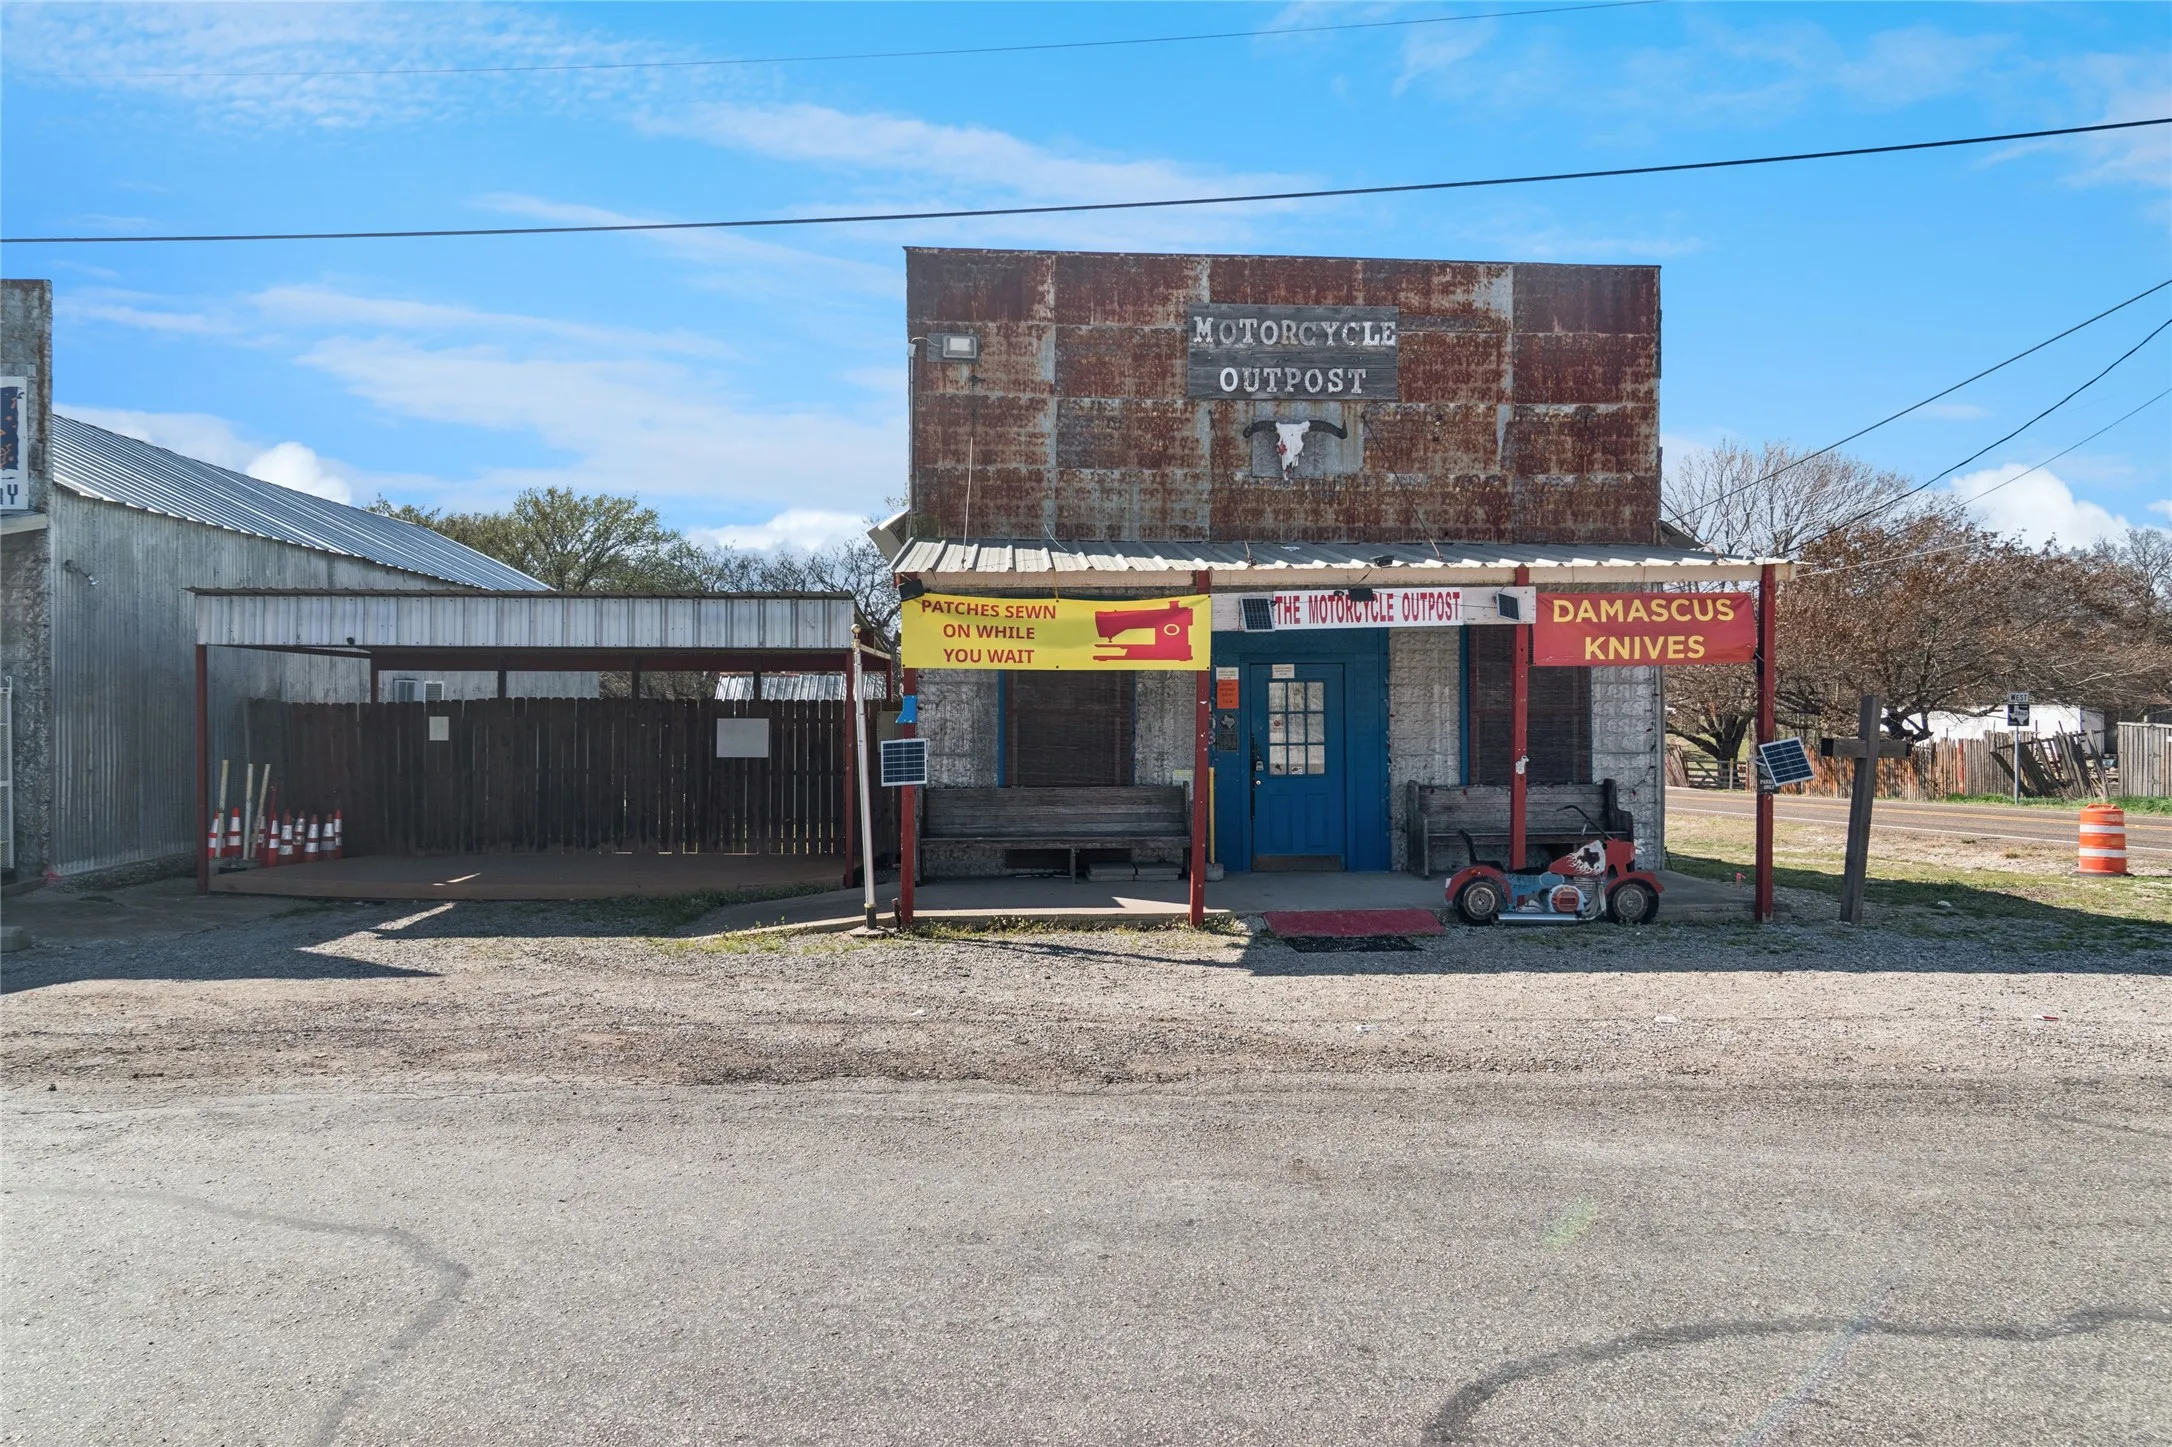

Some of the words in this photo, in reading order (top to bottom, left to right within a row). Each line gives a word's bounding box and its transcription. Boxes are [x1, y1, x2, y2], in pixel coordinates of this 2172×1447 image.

[1193, 316, 1396, 346] MOTORCYCLE
[1219, 367, 1367, 394] OUTPOST
[921, 600, 1000, 617] PATCHES
[1005, 605, 1056, 619] SEWN
[1275, 595, 1300, 625] THE
[1308, 593, 1394, 624] MOTORCYCLE
[1402, 591, 1460, 622] OUTPOST
[1553, 599, 1735, 623] DAMASCUS
[943, 623, 971, 638] ON
[976, 625, 1035, 639] WHILE
[943, 648, 982, 663] YOU
[987, 649, 1035, 664] WAIT
[1585, 635, 1705, 660] KNIVES
